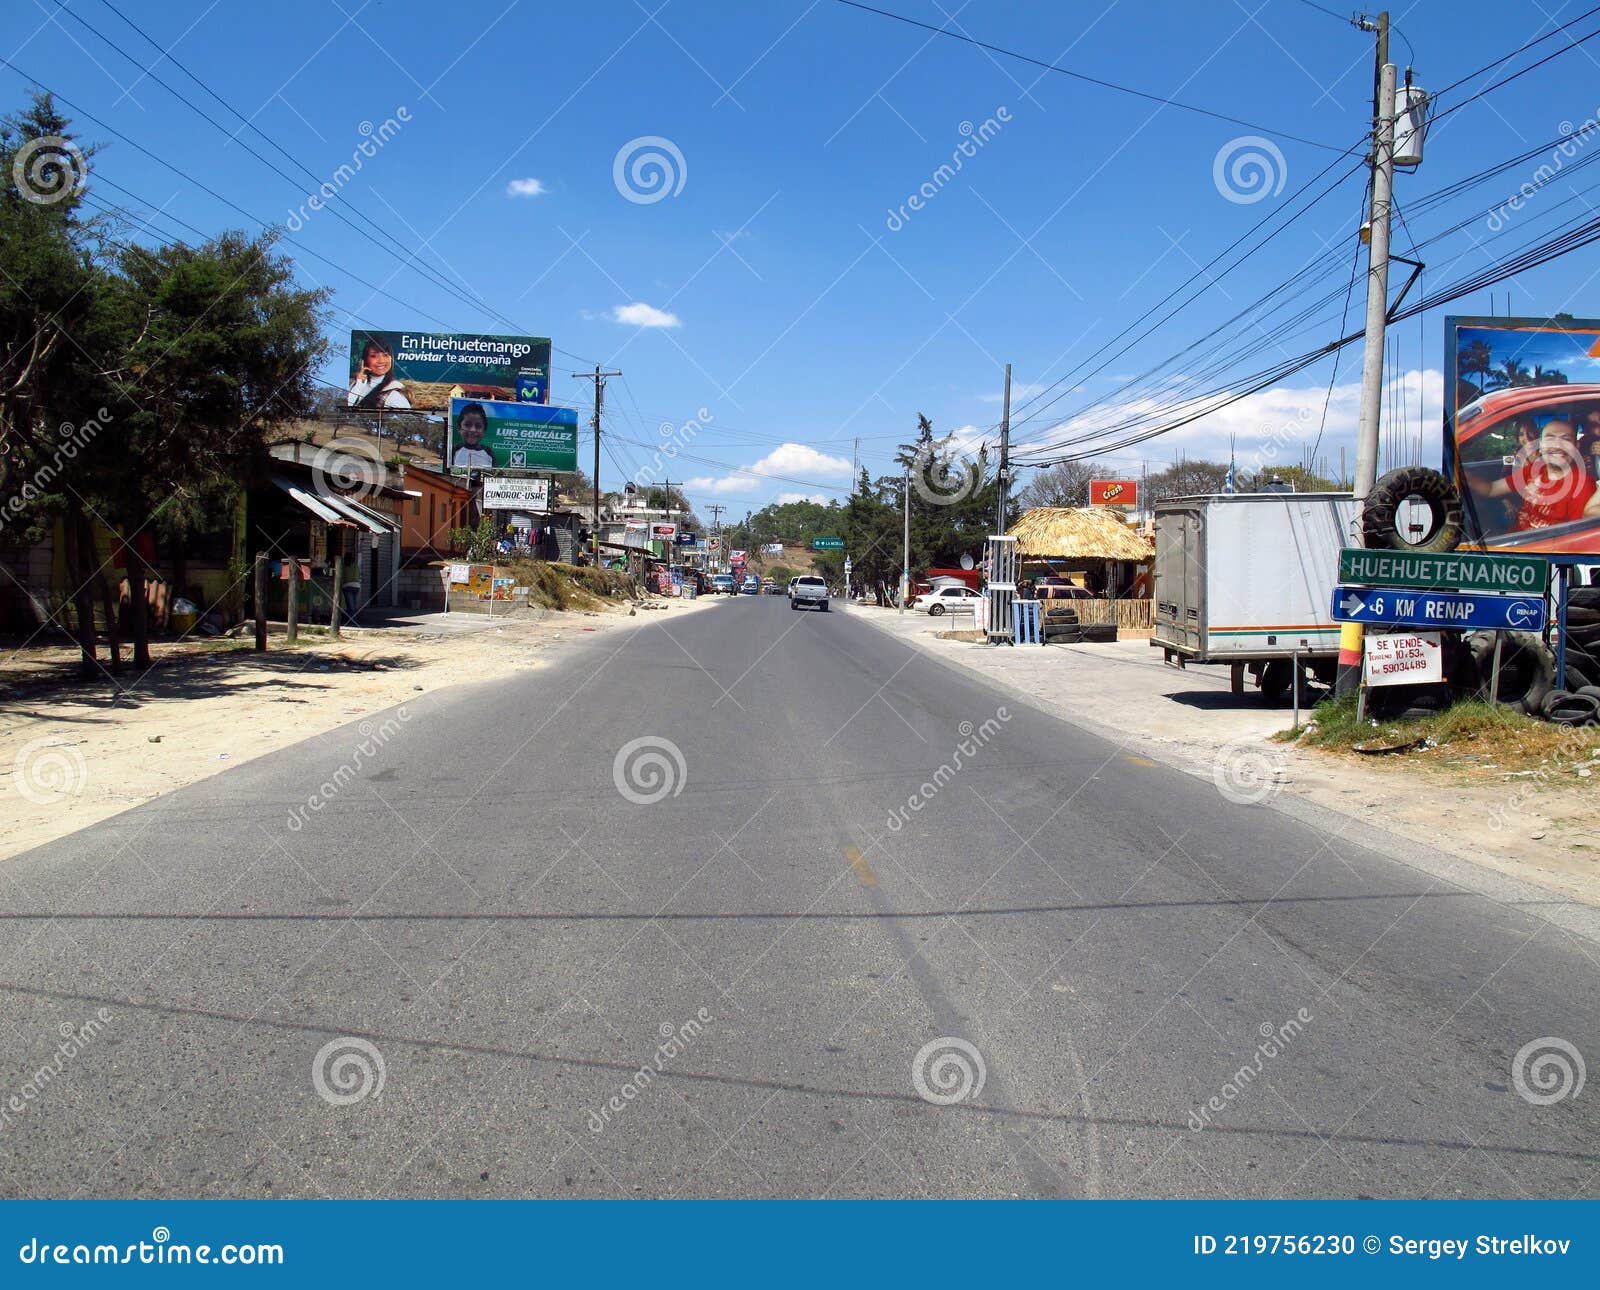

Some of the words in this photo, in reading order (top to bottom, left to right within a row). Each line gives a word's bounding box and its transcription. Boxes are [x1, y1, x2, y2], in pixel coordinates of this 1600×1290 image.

[401, 335, 418, 349] En
[421, 336, 531, 358] Huehuetenango
[397, 351, 444, 362] movistar
[446, 353, 457, 363] te
[458, 354, 511, 367] acompaña
[496, 427, 519, 437] LUIS
[520, 429, 573, 441] GONZÁLEZ
[1103, 484, 1123, 500] Crush
[1351, 557, 1536, 586] HUEHUETENANGO
[1395, 598, 1415, 617] KM
[1425, 600, 1475, 620] RENAP
[1516, 608, 1538, 616] RENAP
[1376, 640, 1389, 650] SE
[1393, 637, 1423, 649] VENDE
[1383, 660, 1427, 674] 59034489
